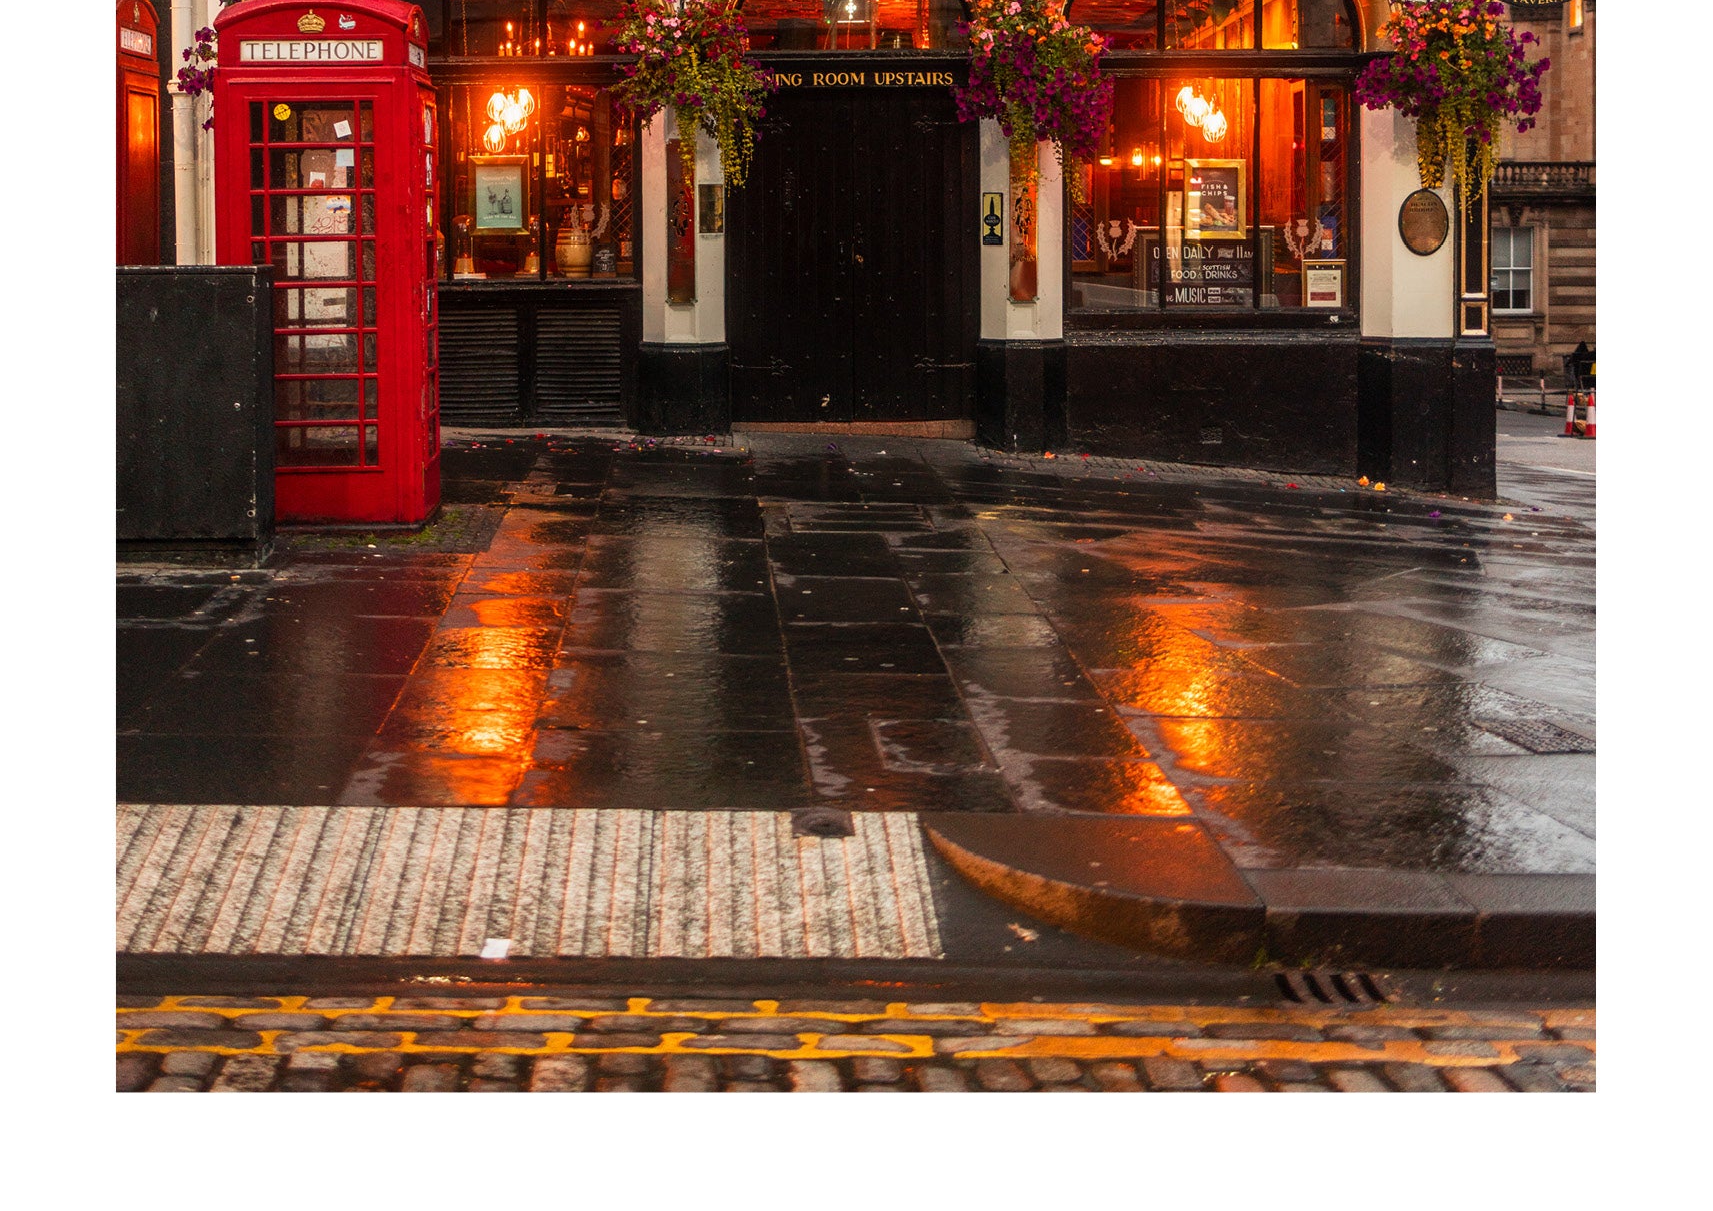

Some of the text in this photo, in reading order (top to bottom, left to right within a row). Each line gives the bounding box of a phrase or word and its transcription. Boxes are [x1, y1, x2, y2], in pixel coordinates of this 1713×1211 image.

[246, 42, 378, 60] TELEPHONE
[813, 72, 865, 86] ROOM
[874, 72, 954, 86] UPSTAIRS
[1153, 247, 1179, 259] OEN
[1183, 244, 1214, 259] DAILY
[1171, 270, 1197, 279] FOOD
[1205, 270, 1238, 279] DRINKS
[1175, 287, 1207, 303] MUSIC
